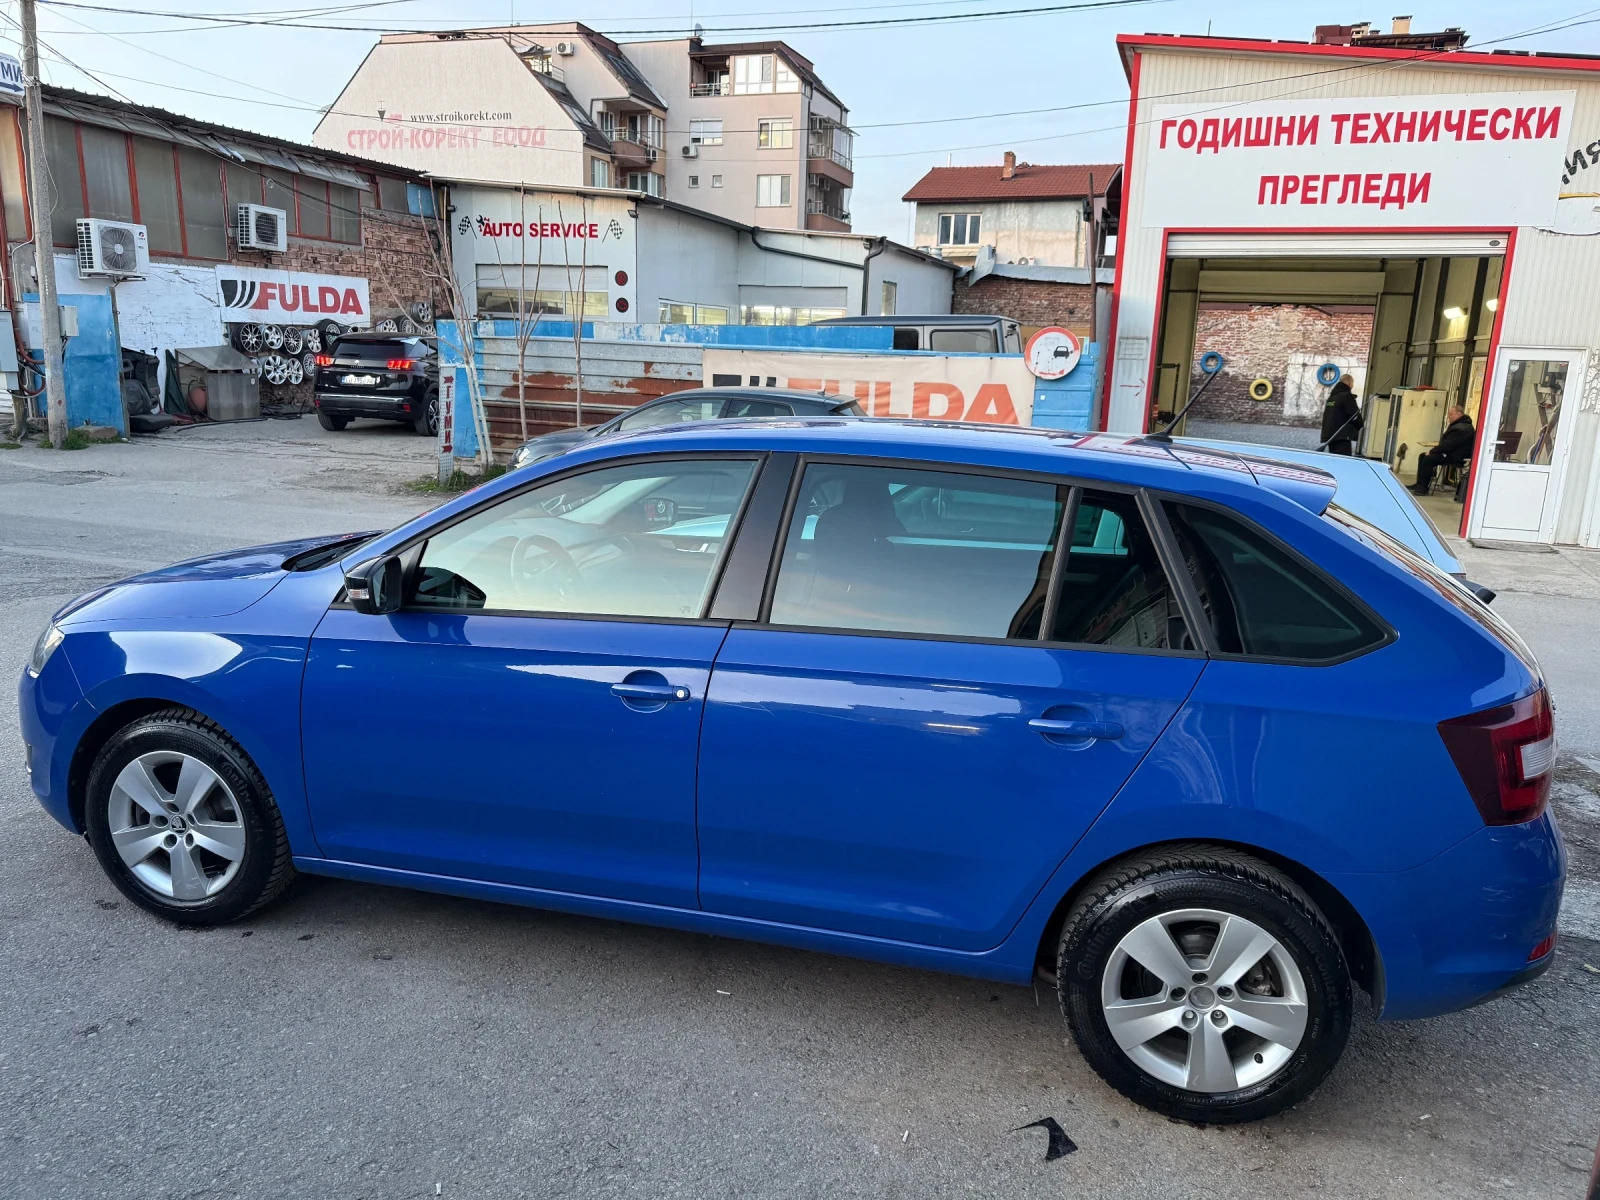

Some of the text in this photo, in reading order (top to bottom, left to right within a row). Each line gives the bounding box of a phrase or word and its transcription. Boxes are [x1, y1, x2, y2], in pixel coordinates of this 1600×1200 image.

[410, 110, 512, 122] www.stroikorekt.com
[1159, 106, 1561, 154] ГОДИШНИ ТЕХНИЧЕСКИ
[347, 125, 546, 150] СТРОЙ-КОРЕКТ ЕООД
[1257, 172, 1431, 210] ПРЕГЛЕДИ
[483, 223, 598, 238] AUTO SERVICE
[249, 281, 363, 315] FULDA
[444, 385, 452, 444] ГУМИ
[787, 377, 1020, 425] LDA
